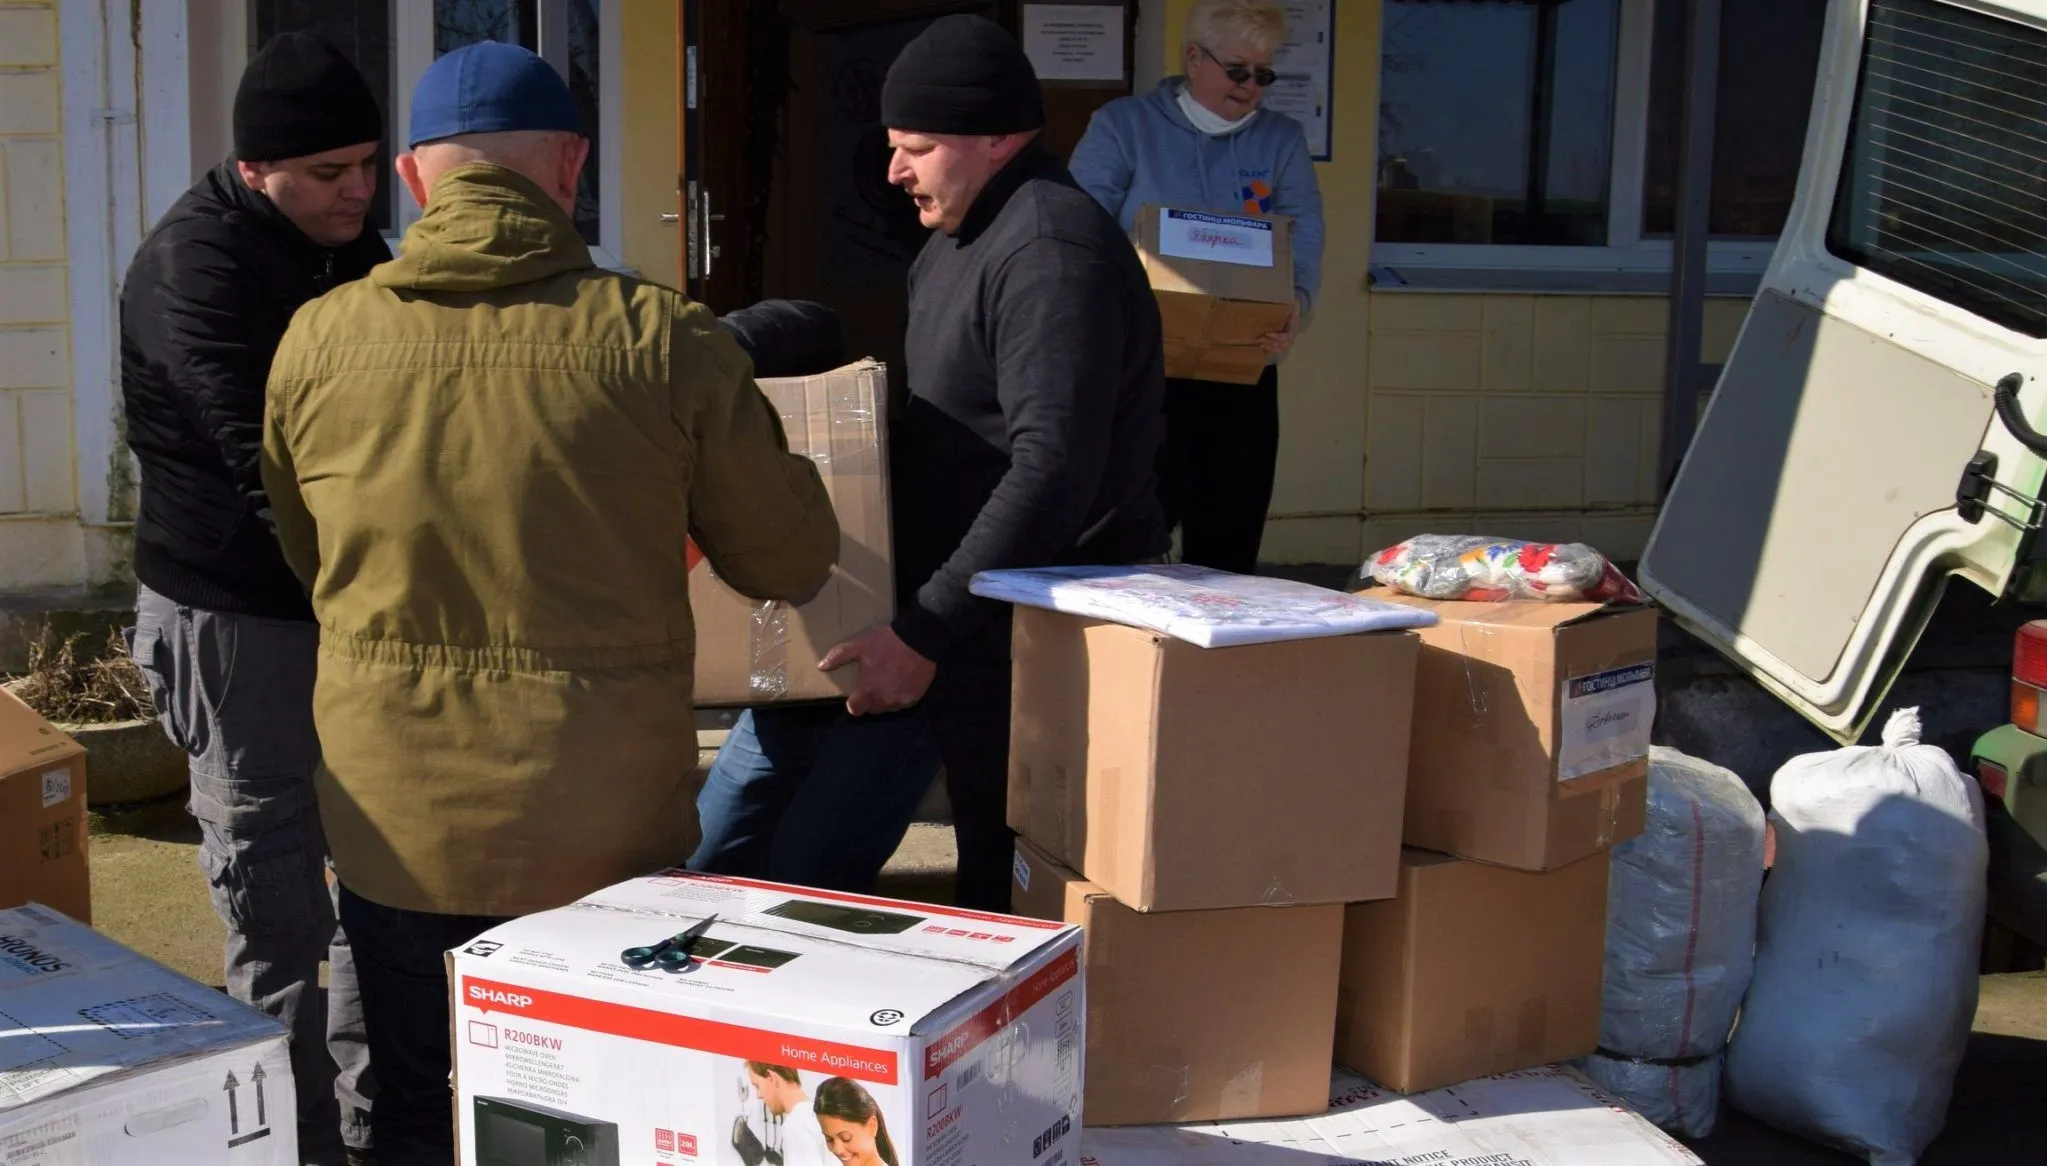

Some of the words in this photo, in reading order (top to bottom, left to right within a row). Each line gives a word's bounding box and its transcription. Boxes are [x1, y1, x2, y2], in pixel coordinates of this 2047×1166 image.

[469, 985, 533, 1009] SHARP
[504, 1027, 562, 1050] R200BKW
[929, 1031, 969, 1067] SHARP
[505, 1044, 538, 1057] MICROWAVE
[540, 1051, 556, 1060] OVEN
[781, 1044, 817, 1061] Home
[821, 1051, 888, 1074] Appliances
[16, 1079, 41, 1092] LIFT
[926, 1104, 961, 1140] R200BKW
[1402, 1149, 1452, 1164] NOTICE
[1451, 1152, 1513, 1166] PRODUCT
